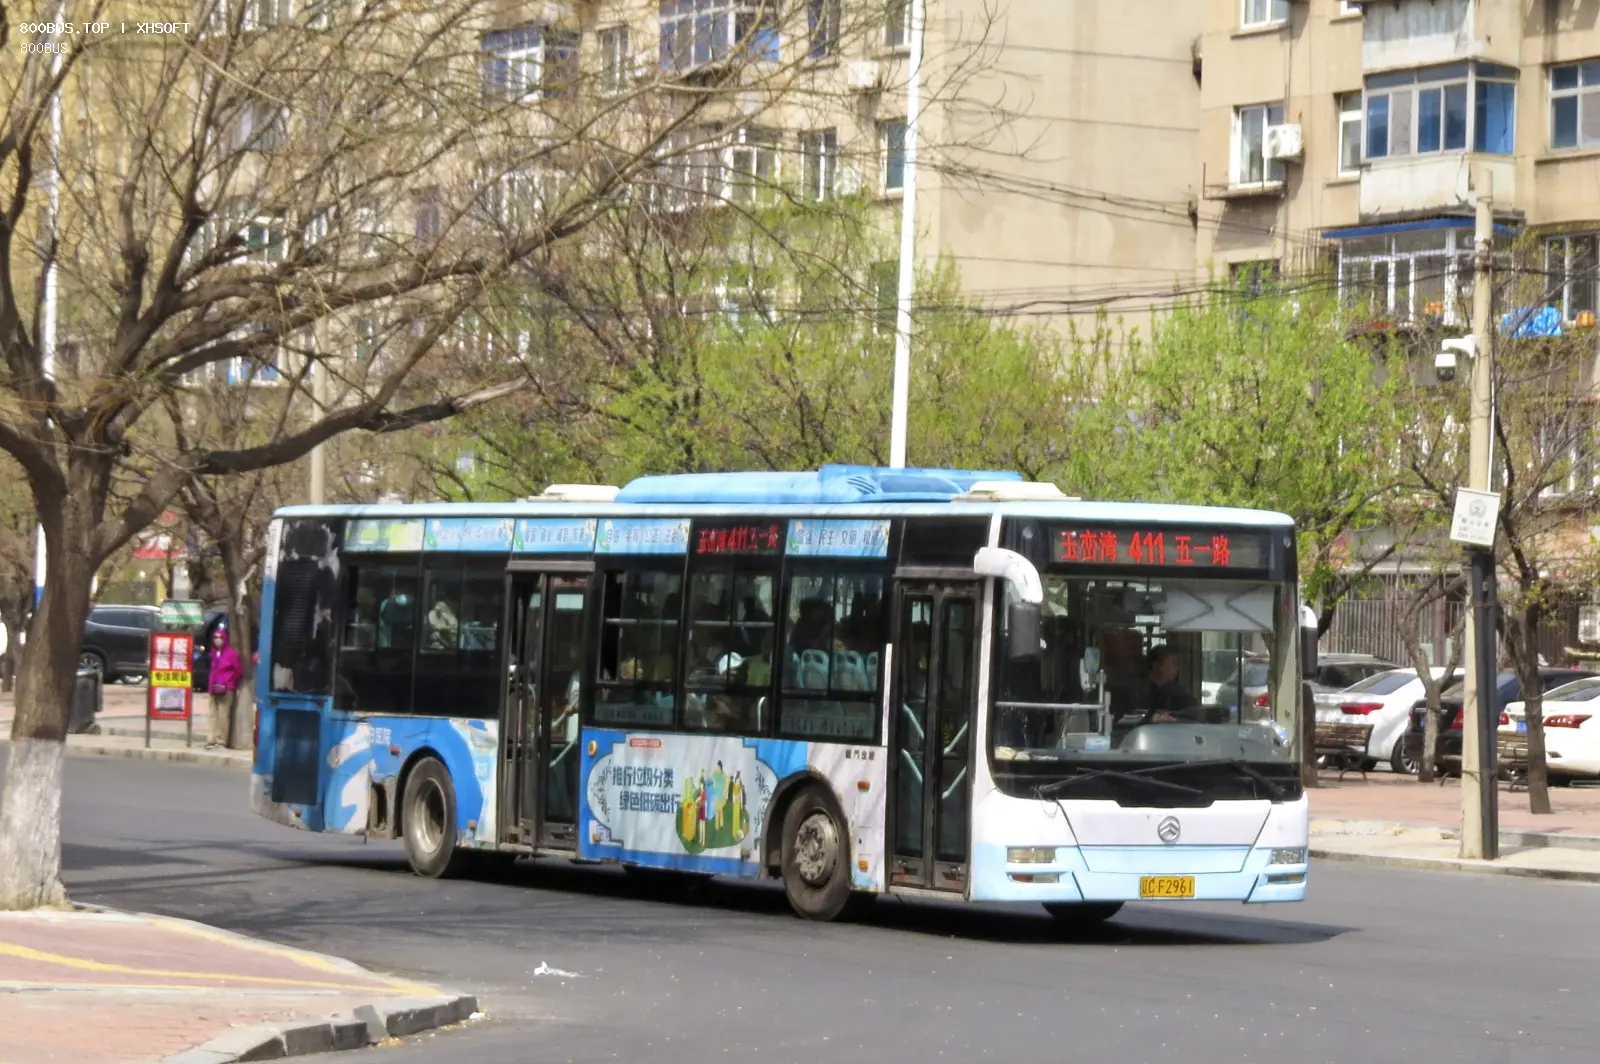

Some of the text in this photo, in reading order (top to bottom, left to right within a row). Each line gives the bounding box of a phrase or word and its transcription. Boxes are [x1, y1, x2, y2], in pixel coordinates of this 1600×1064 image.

[1128, 531, 1165, 564] 411
[1175, 534, 1231, 567] 五一路
[612, 765, 674, 789] 推行垃圾分类
[619, 791, 681, 815] 绿色低碳出行
